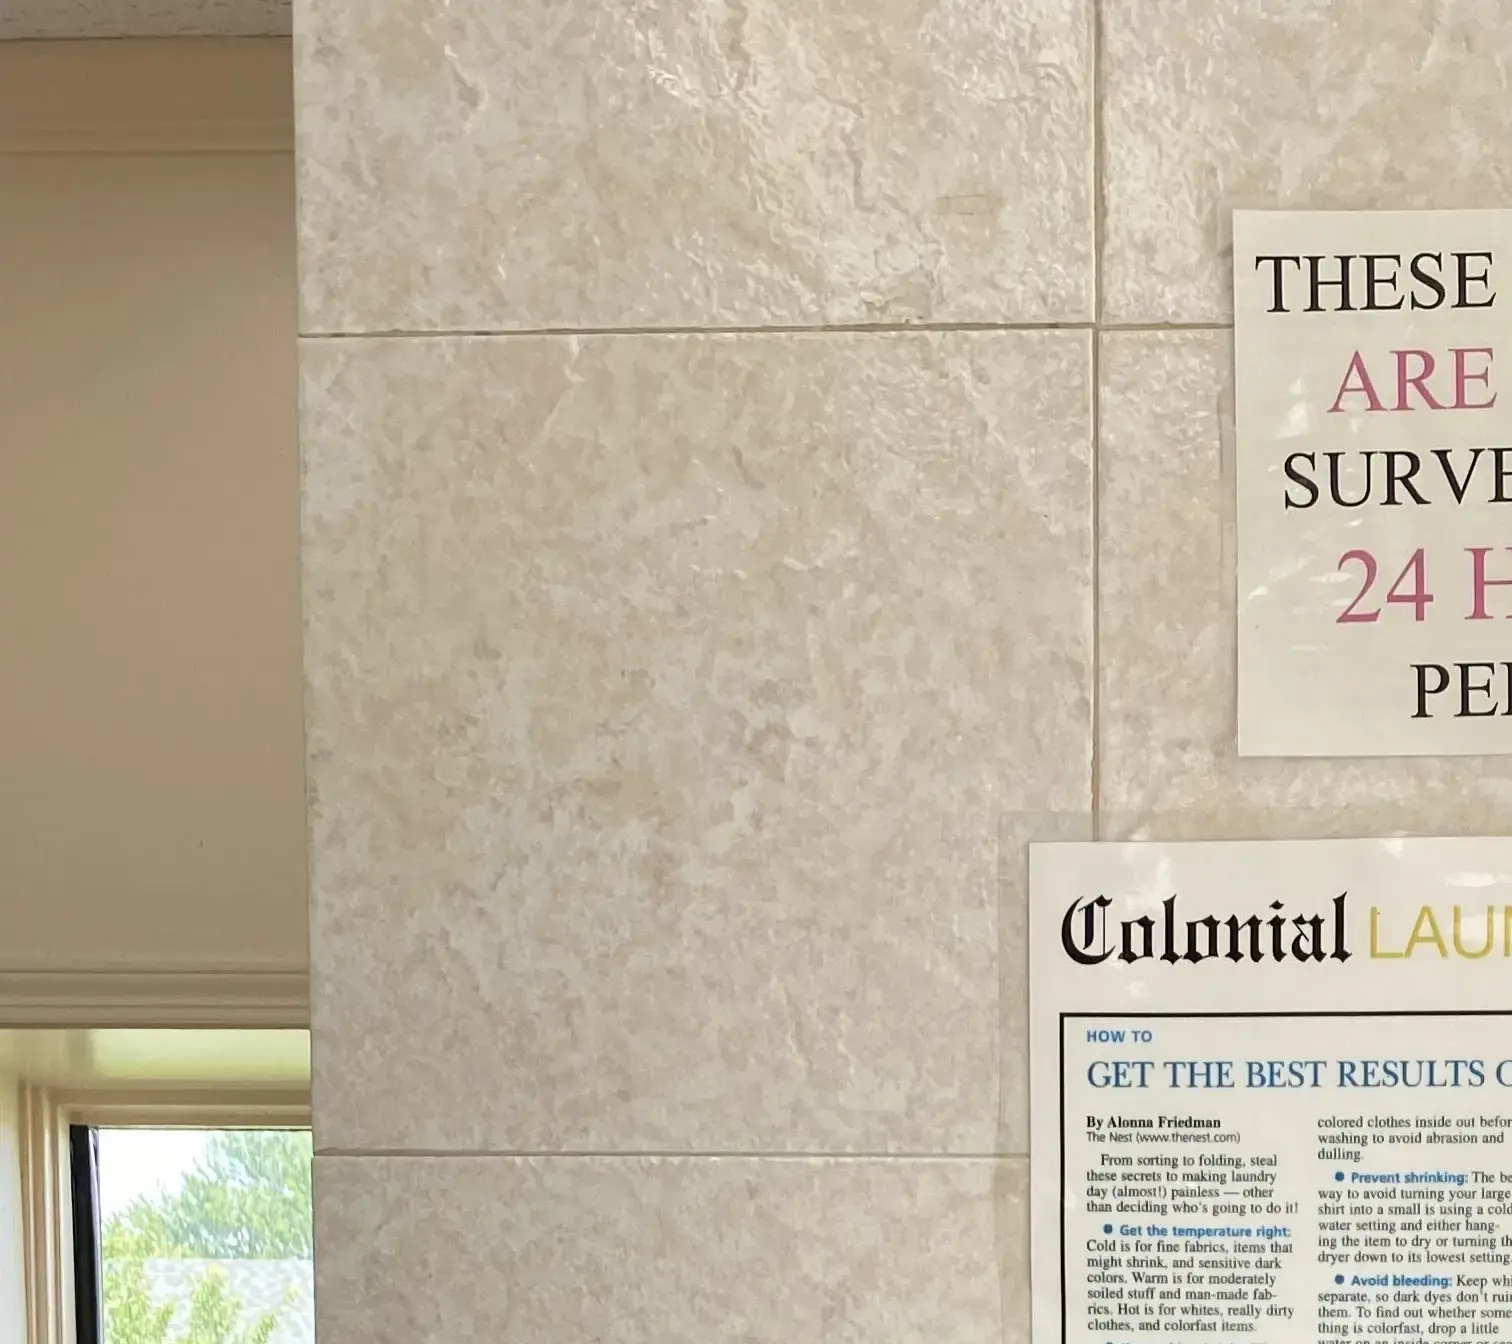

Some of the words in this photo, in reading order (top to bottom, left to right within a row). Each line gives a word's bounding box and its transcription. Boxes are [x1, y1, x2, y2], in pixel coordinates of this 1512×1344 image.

[1255, 252, 1496, 312] THESE
[1327, 348, 1497, 413] ARE
[1336, 548, 1434, 623] 24
[1061, 891, 1353, 965] Colonial
[1087, 1030, 1125, 1043] HOW
[1131, 1030, 1152, 1043] TO
[1087, 1061, 1155, 1088] GET
[1163, 1061, 1235, 1088] THE
[1246, 1061, 1327, 1088] BEST
[1337, 1060, 1485, 1087] RESULTS
[1087, 1116, 1103, 1130] By
[1107, 1116, 1153, 1128] Alonna
[1158, 1116, 1221, 1128] Friedman
[1317, 1116, 1363, 1128] colored
[1367, 1115, 1411, 1128] clothes
[1415, 1115, 1451, 1128] inside
[1456, 1117, 1475, 1128] out
[1086, 1131, 1106, 1143] The
[1109, 1132, 1132, 1143] Nest
[1136, 1132, 1240, 1144] (www.thenest.com)
[1101, 1153, 1133, 1166] From
[1137, 1154, 1179, 1169] sorting
[1183, 1156, 1195, 1166] to
[1199, 1154, 1246, 1169] folding,
[1250, 1154, 1277, 1166] steal
[1086, 1169, 1117, 1181] these
[1121, 1172, 1162, 1182] secrets
[1166, 1171, 1178, 1182] to
[1182, 1170, 1227, 1185] making
[1231, 1170, 1276, 1185] laundry
[1351, 1172, 1401, 1184] Prevent
[1404, 1171, 1468, 1186] shrinking:
[1471, 1171, 1495, 1183] The
[1120, 1224, 1143, 1236] Get
[1146, 1224, 1168, 1237] the
[1172, 1226, 1252, 1240] temperature
[1256, 1225, 1291, 1240] right:
[1351, 1274, 1389, 1286] Avoid
[1392, 1274, 1452, 1289] bleeding:
[1456, 1274, 1488, 1291] Keep
